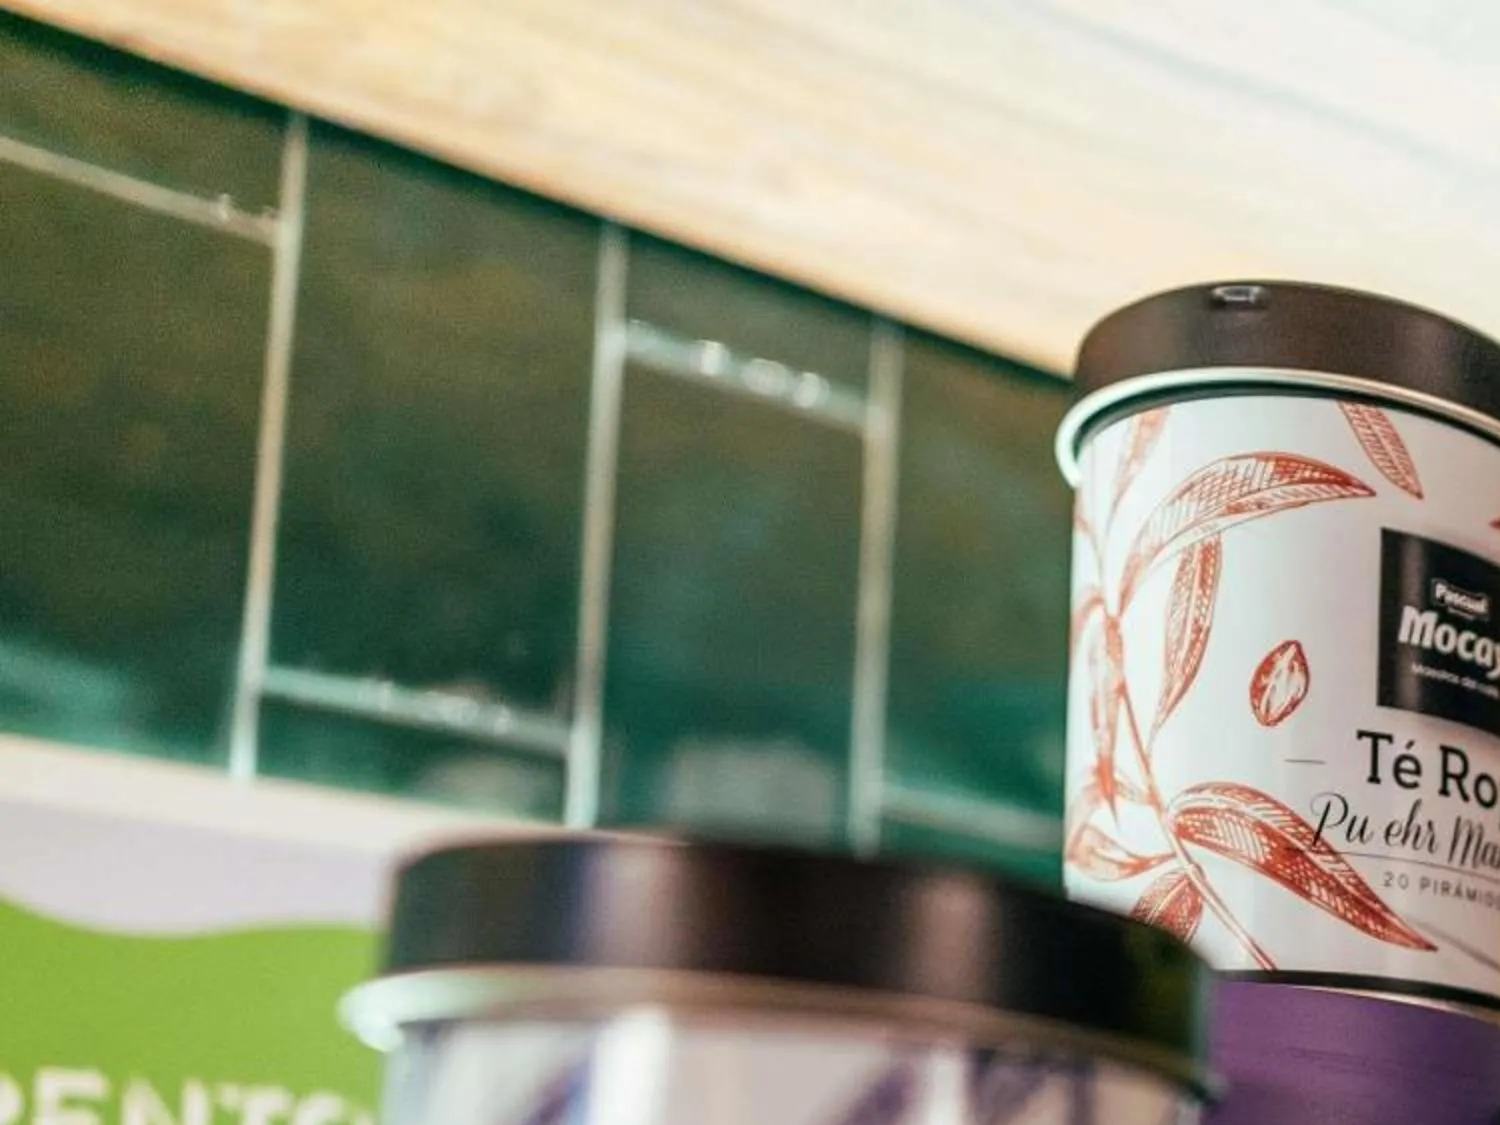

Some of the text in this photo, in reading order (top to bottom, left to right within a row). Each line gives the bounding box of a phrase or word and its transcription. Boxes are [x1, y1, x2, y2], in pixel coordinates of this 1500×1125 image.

[1356, 729, 1422, 790] Té
[1309, 792, 1374, 848] Pu
[1383, 799, 1440, 856] ehr
[1382, 871, 1409, 892] 20
